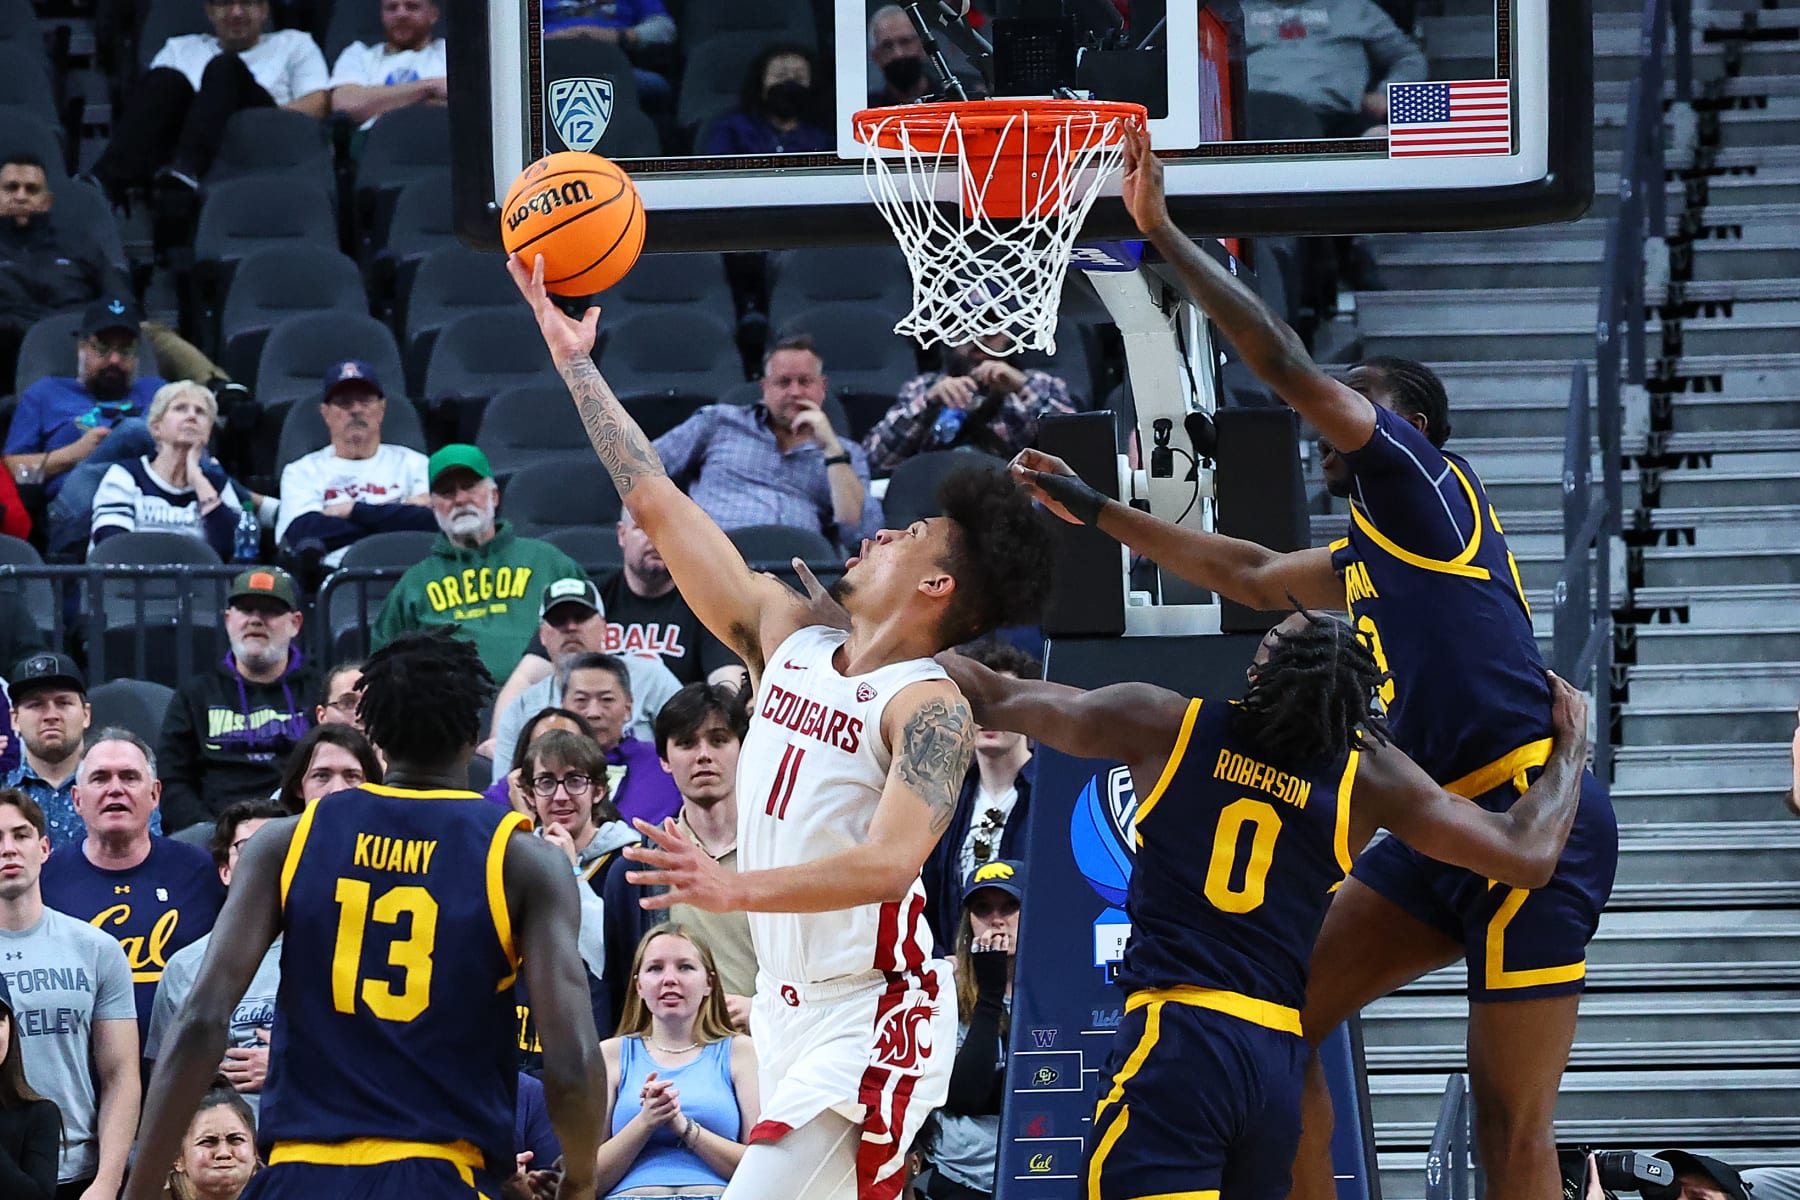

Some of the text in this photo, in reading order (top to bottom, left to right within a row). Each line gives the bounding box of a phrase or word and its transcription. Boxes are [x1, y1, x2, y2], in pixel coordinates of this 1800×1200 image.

[551, 80, 612, 123] PAC
[569, 120, 594, 143] 12
[506, 179, 594, 232] Wilson
[426, 566, 532, 612] OREGON
[761, 684, 864, 754] COUGARS
[765, 743, 806, 820] 11
[1213, 749, 1311, 809] ROBERSON
[354, 832, 438, 874] KUANY
[1204, 798, 1282, 914] 0
[332, 877, 439, 1022] 13
[1032, 1029, 1057, 1047] W
[1029, 1153, 1052, 1171] Cal
